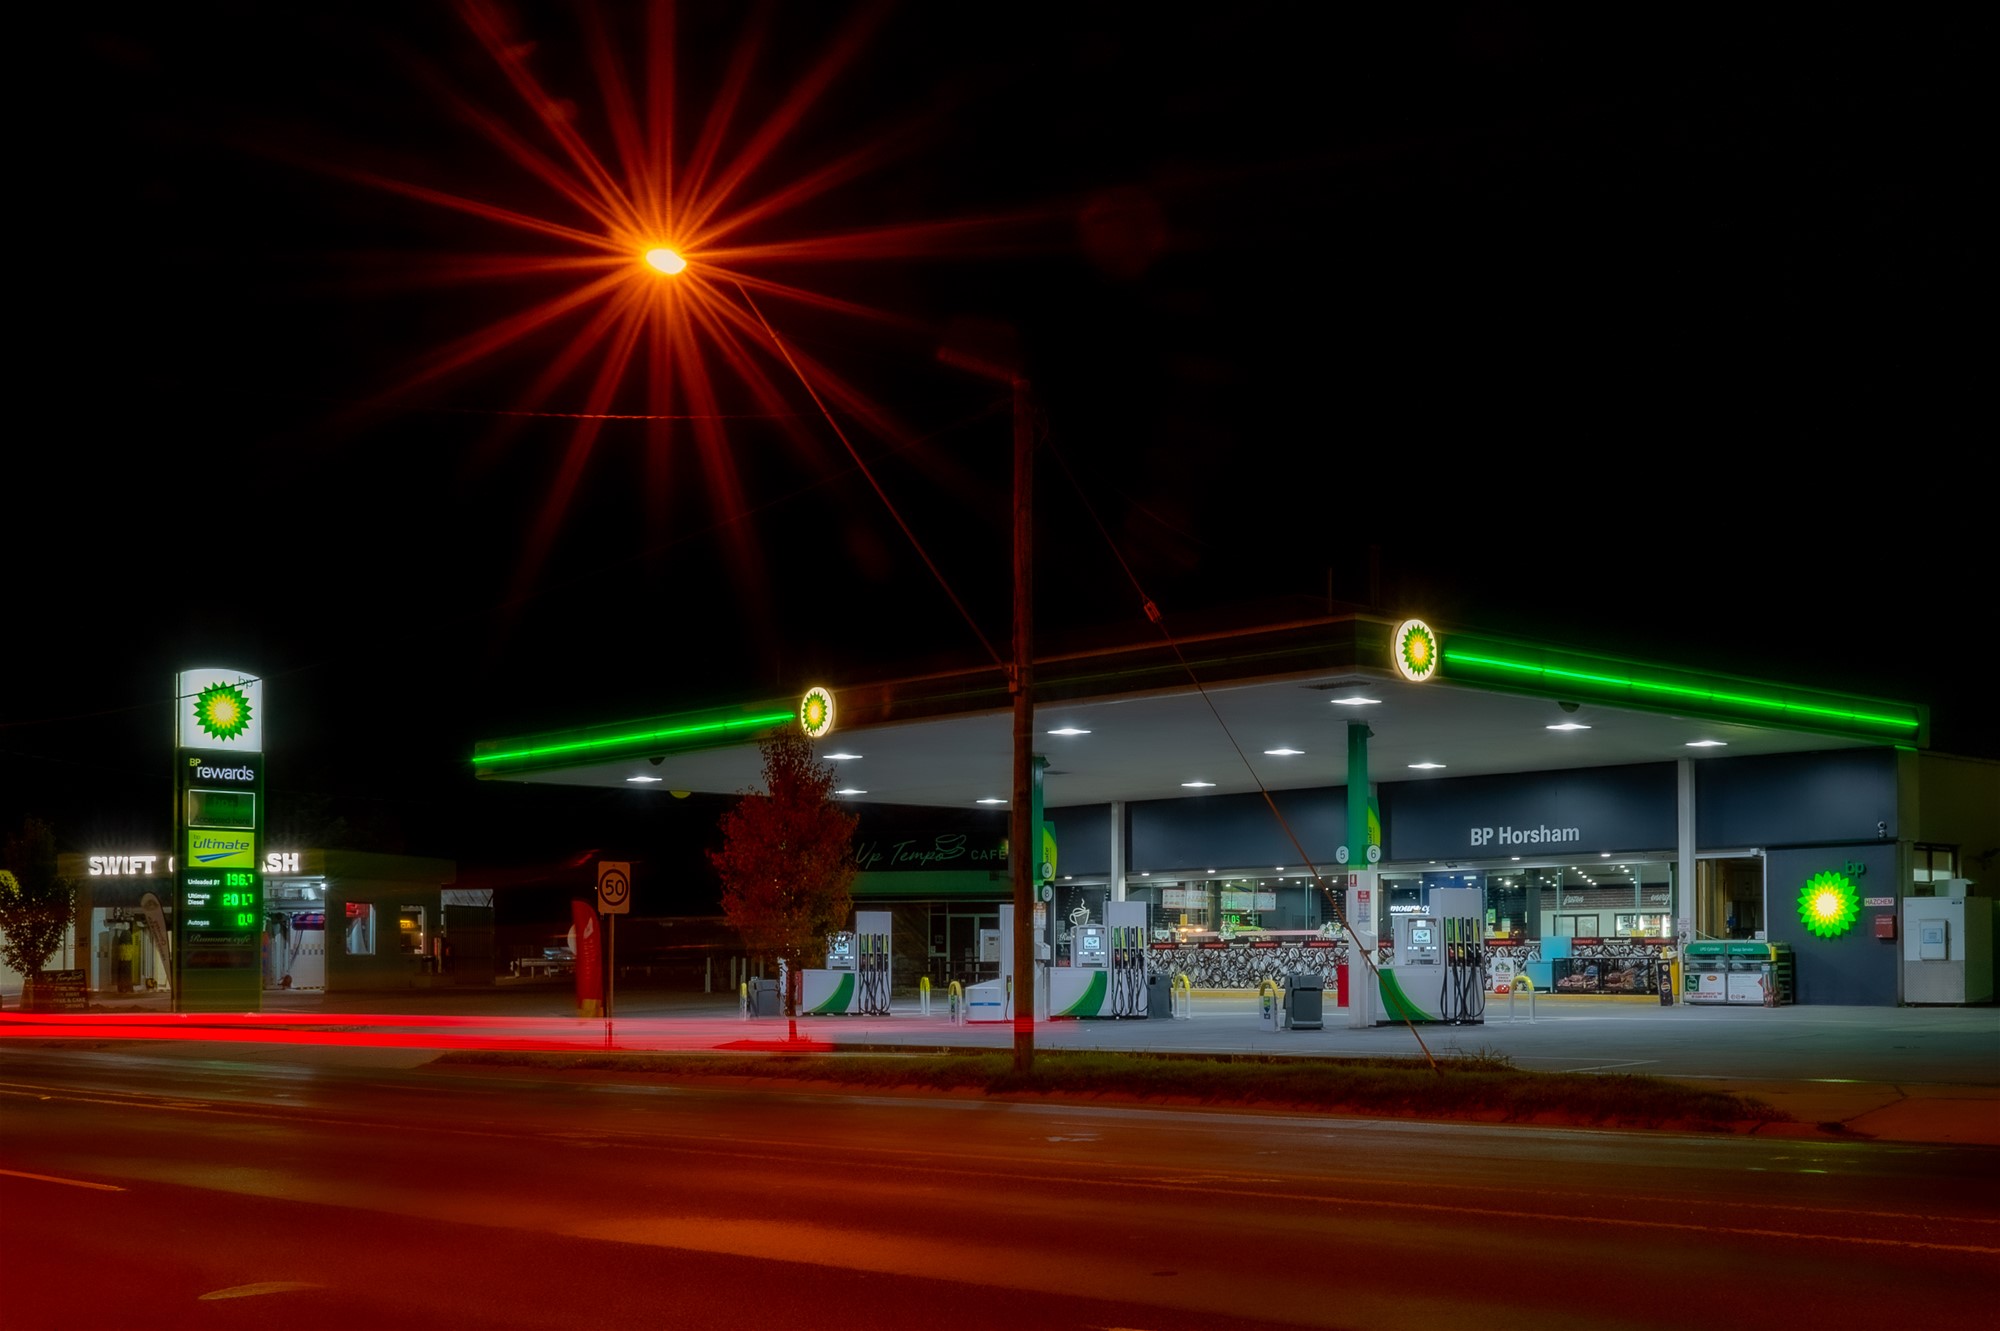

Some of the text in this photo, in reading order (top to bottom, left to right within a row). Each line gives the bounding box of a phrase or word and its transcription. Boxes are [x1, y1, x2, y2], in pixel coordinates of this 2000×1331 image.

[189, 758, 202, 767] BP
[197, 766, 254, 781] rewards
[1470, 824, 1580, 846] BP Horsham
[193, 839, 250, 850] ultimate
[855, 841, 882, 870] Up
[890, 839, 945, 866] Tempo
[88, 855, 157, 876] SWIFT
[1845, 860, 1866, 878] bp
[226, 873, 254, 887] 196.7
[605, 879, 625, 896] 50
[187, 892, 211, 900] Ultimate
